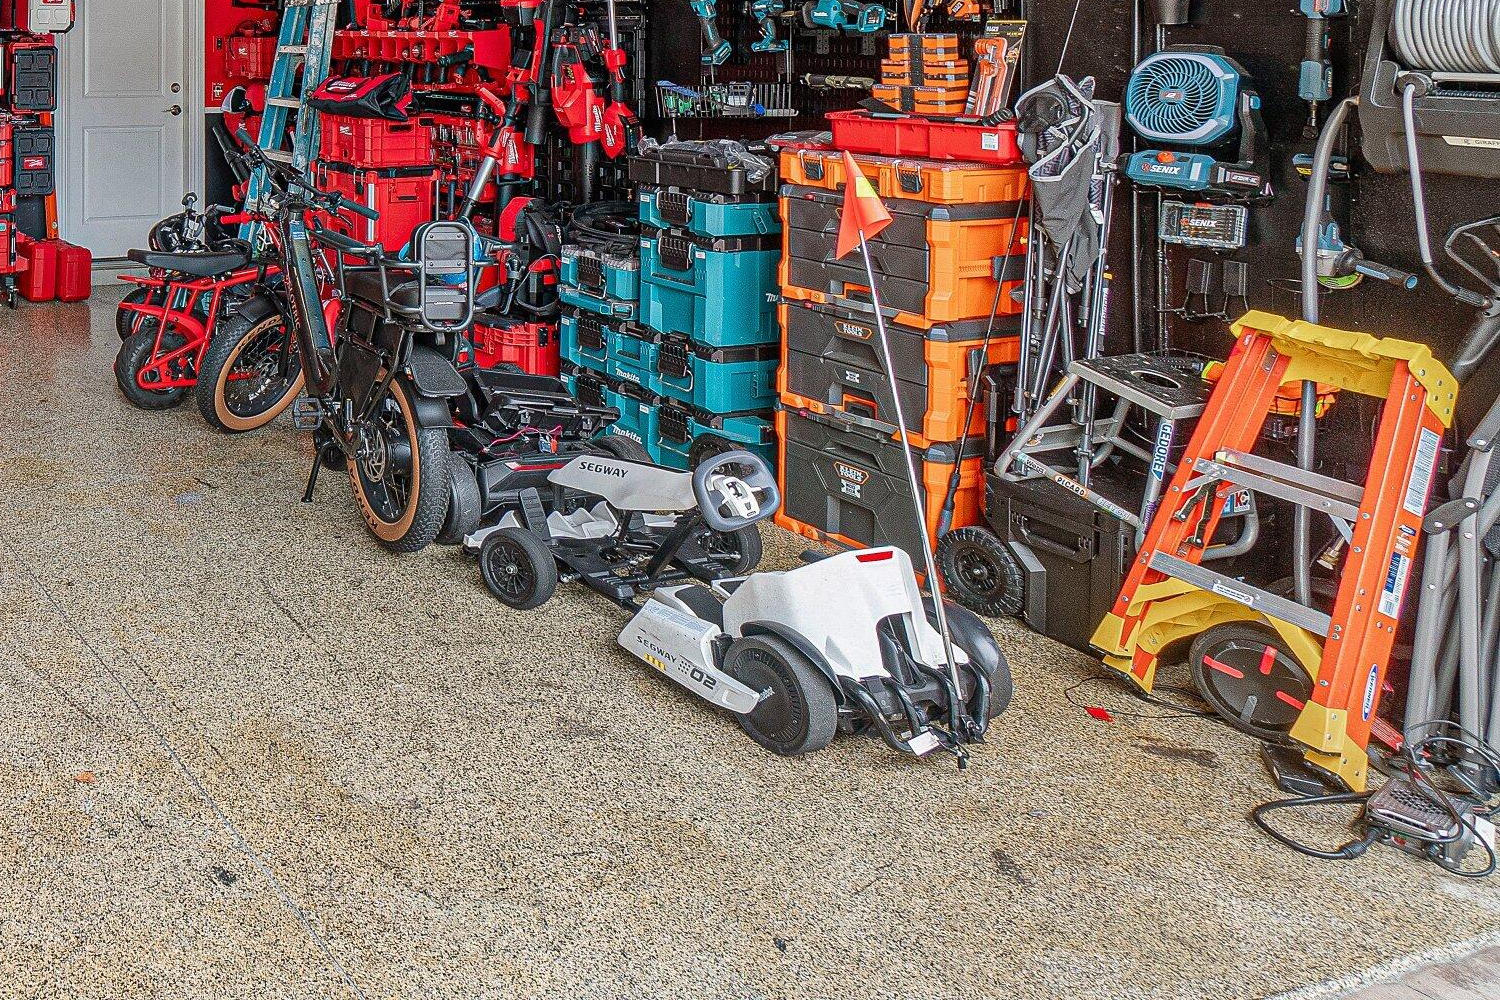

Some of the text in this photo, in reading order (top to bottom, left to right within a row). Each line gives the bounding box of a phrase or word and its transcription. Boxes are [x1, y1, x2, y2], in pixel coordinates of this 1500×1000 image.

[1150, 164, 1181, 175] SENIX
[1189, 218, 1218, 228] SENIX
[1154, 423, 1173, 478] GEDORE
[578, 461, 629, 479] SEGWAY
[1056, 476, 1085, 496] PICARD
[637, 635, 677, 662] SEGWAY
[689, 667, 716, 690] 02
